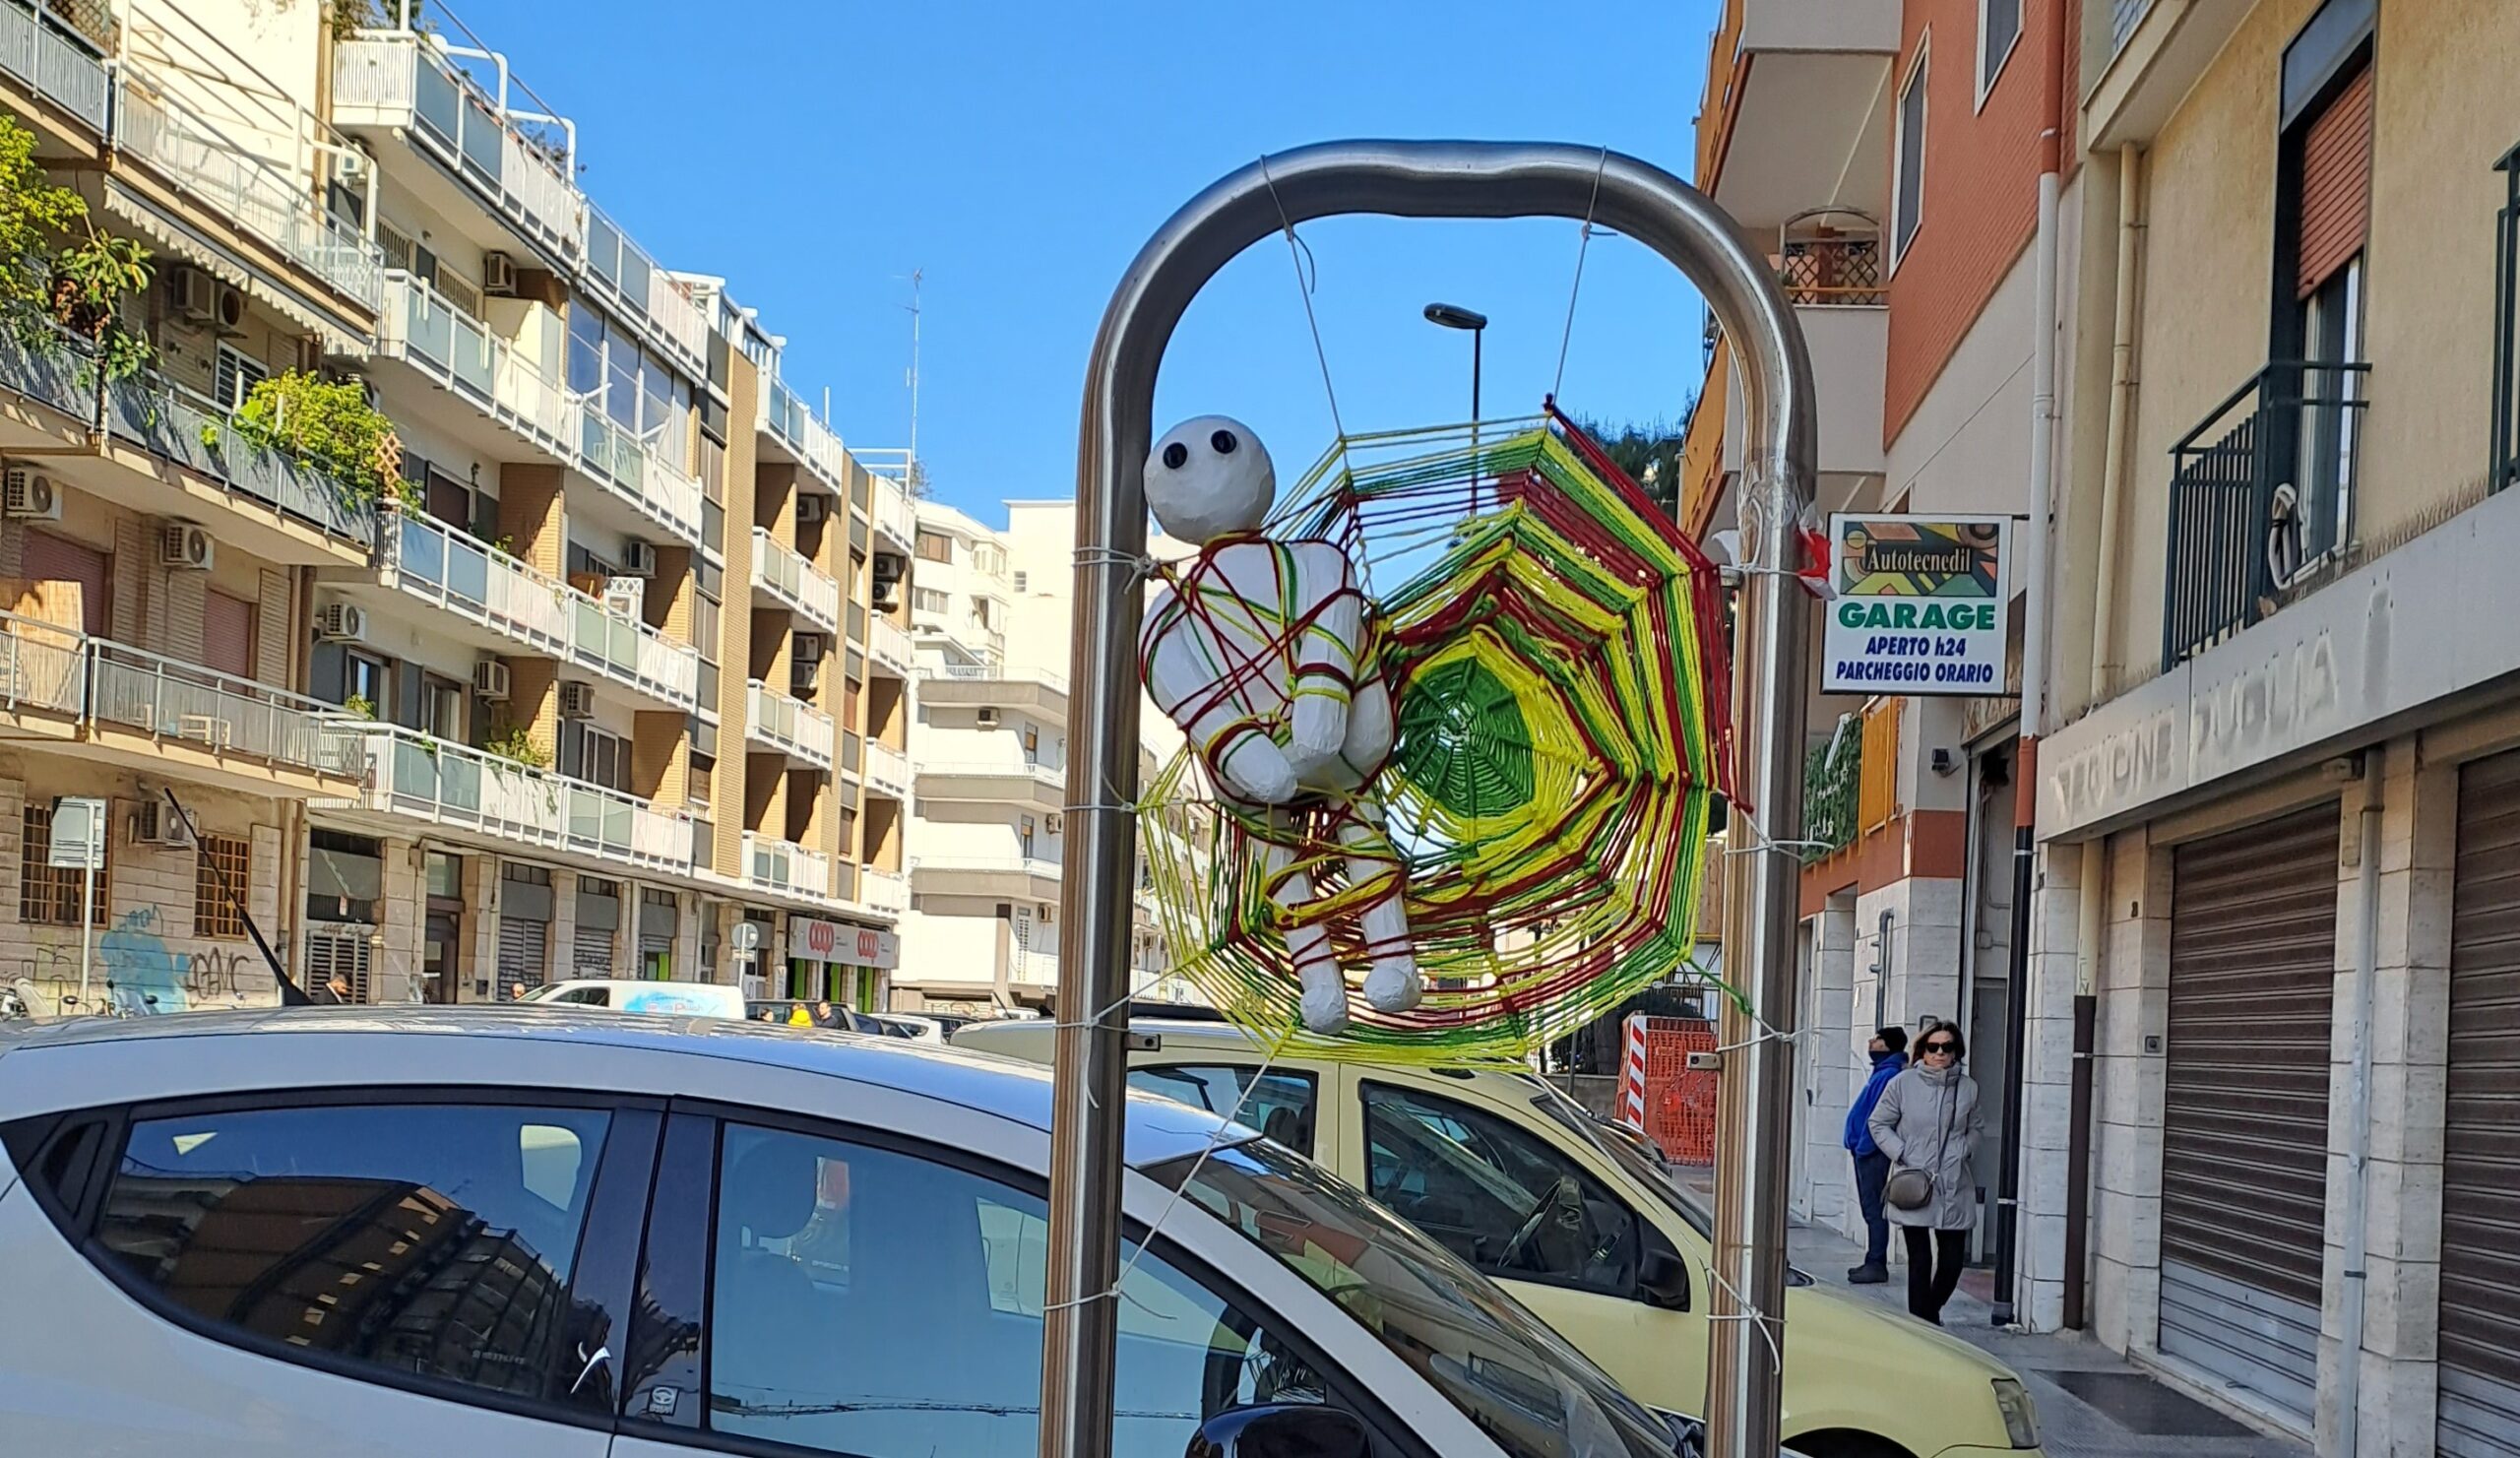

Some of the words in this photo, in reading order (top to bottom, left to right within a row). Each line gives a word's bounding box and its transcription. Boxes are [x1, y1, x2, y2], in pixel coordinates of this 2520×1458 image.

[1867, 546, 1972, 573] Autotecnedil
[1838, 602, 1996, 630] GARAGE
[1864, 636, 1930, 657] APERTO
[1934, 636, 1967, 657] h24
[1835, 661, 1930, 681] PARCHEGGIO
[1935, 663, 1994, 683] ORARIO
